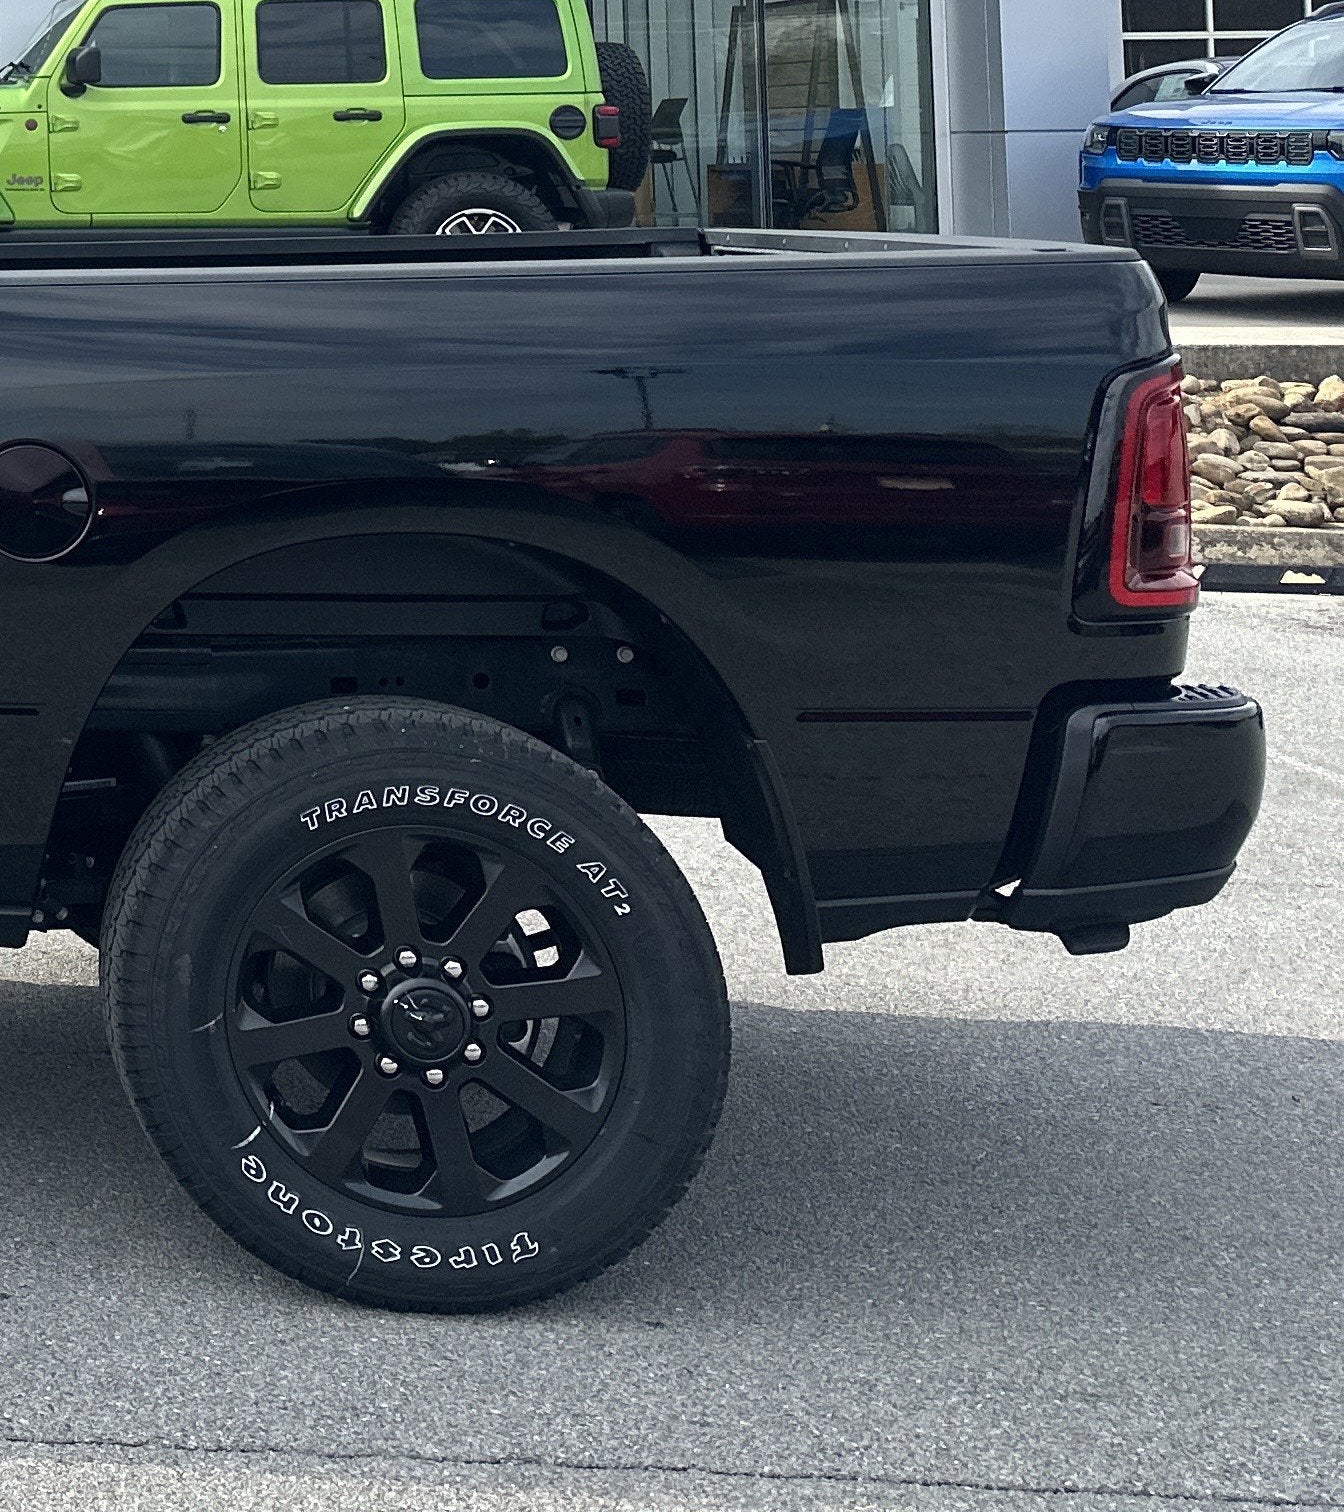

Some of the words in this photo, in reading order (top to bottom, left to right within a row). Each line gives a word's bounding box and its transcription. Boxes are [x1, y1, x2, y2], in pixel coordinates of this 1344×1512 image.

[6, 173, 44, 187] Jeep
[300, 785, 575, 854] TRANSFORCE
[240, 1154, 540, 1269] Firestone
